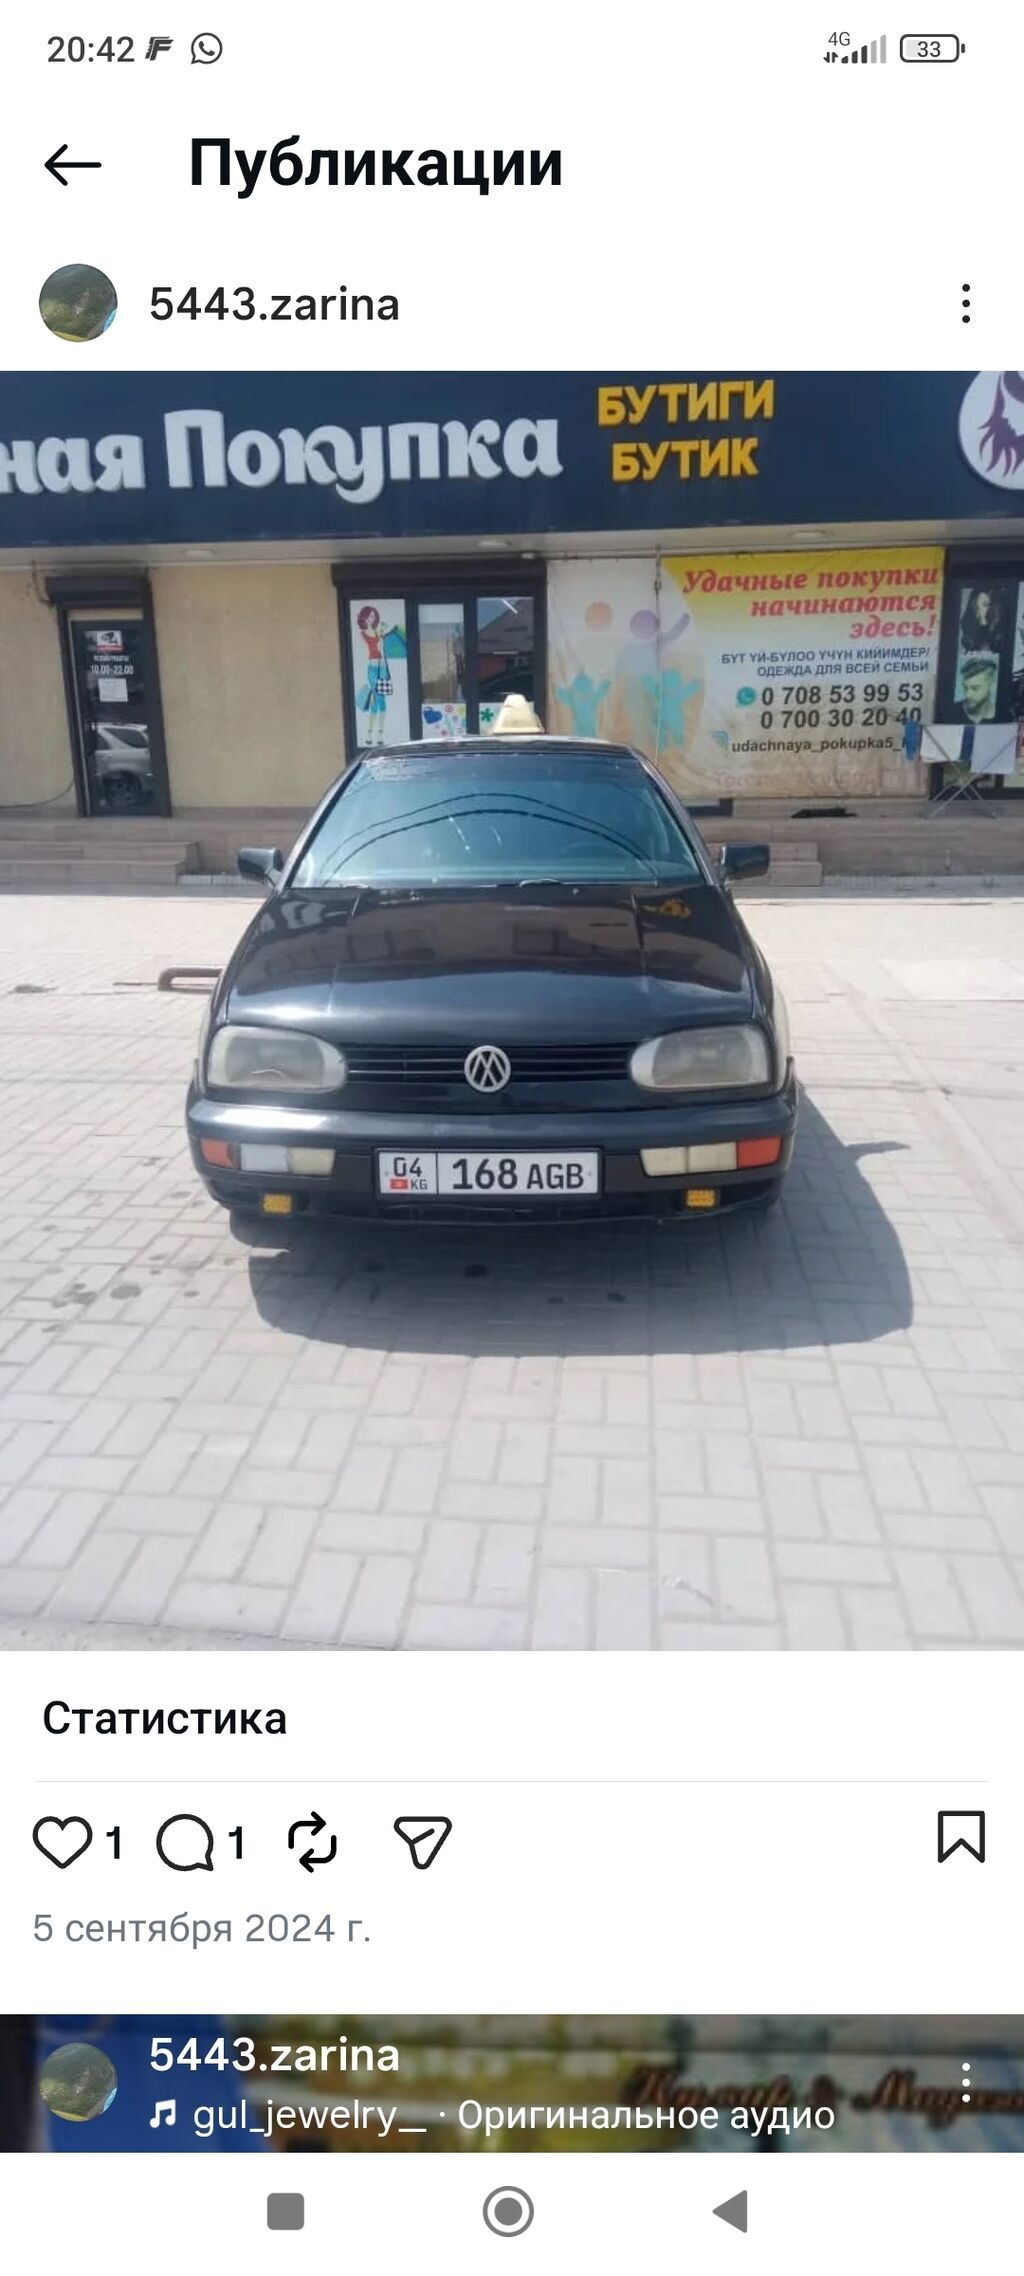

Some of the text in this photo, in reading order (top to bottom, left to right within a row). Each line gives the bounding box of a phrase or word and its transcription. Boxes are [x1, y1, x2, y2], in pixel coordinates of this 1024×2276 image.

[598, 379, 774, 426] БУТИГИ
[164, 409, 563, 505] Покупка
[612, 437, 759, 482] БУТИК
[682, 567, 939, 594] Удачные покупки
[751, 594, 936, 617] начинаются
[849, 614, 937, 639] здесь!
[757, 661, 928, 678] ОДЕЖДА ДЛЯ ВСЕЙ СЕМЬИ
[762, 683, 924, 706] 0 708 53 99 53
[760, 711, 773, 729] 0
[781, 710, 820, 729] 700
[828, 709, 854, 728] 30
[862, 707, 888, 727] 20
[732, 736, 909, 753] udachnaya_pokupka5_
[393, 1156, 584, 1190] 04 168 AGB
[410, 1179, 428, 1190] KG
